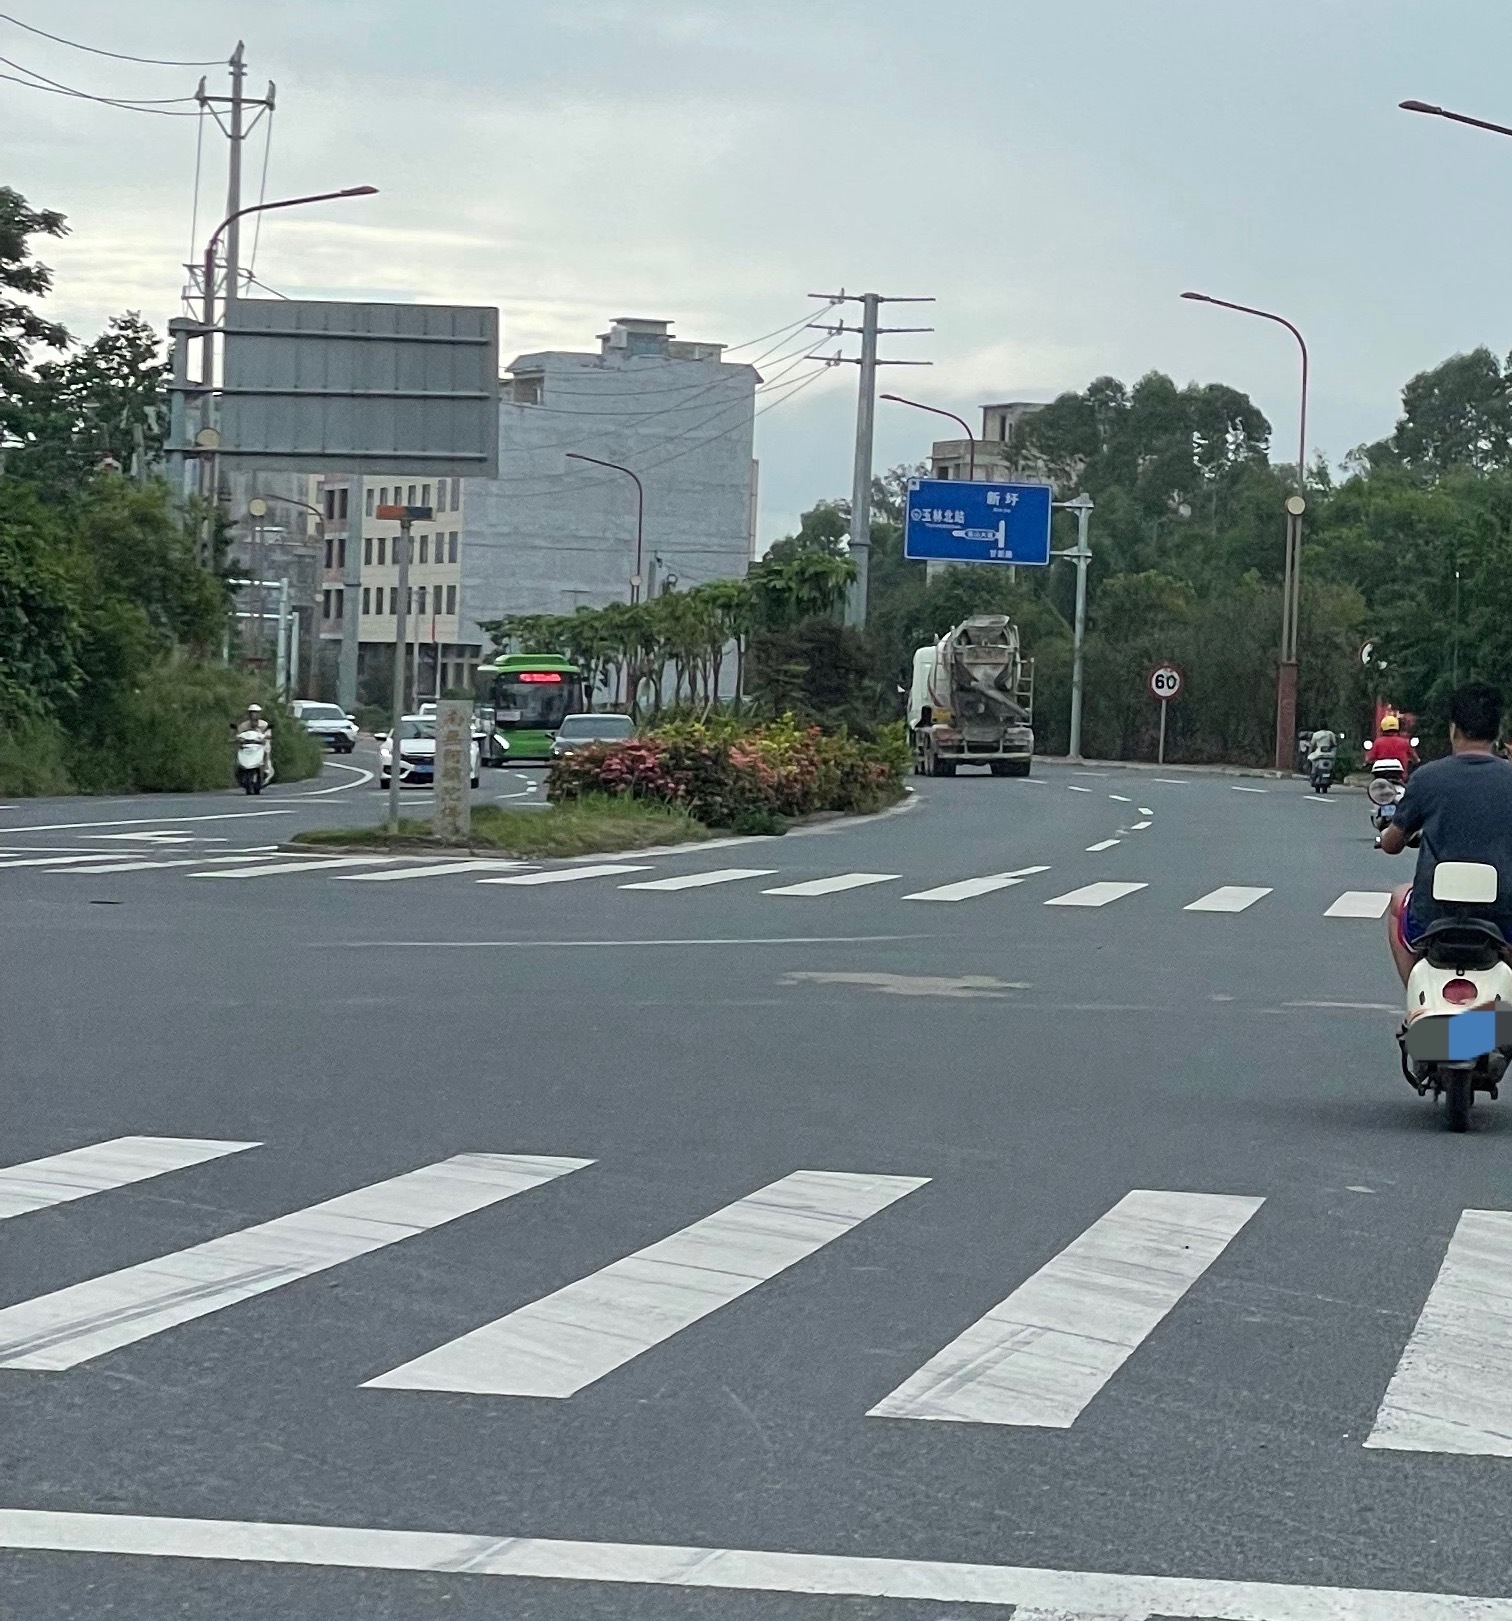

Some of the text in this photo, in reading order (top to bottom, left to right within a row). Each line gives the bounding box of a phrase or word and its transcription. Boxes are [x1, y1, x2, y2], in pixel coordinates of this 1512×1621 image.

[921, 508, 965, 525] 玉林北站
[1155, 673, 1177, 689] 60
